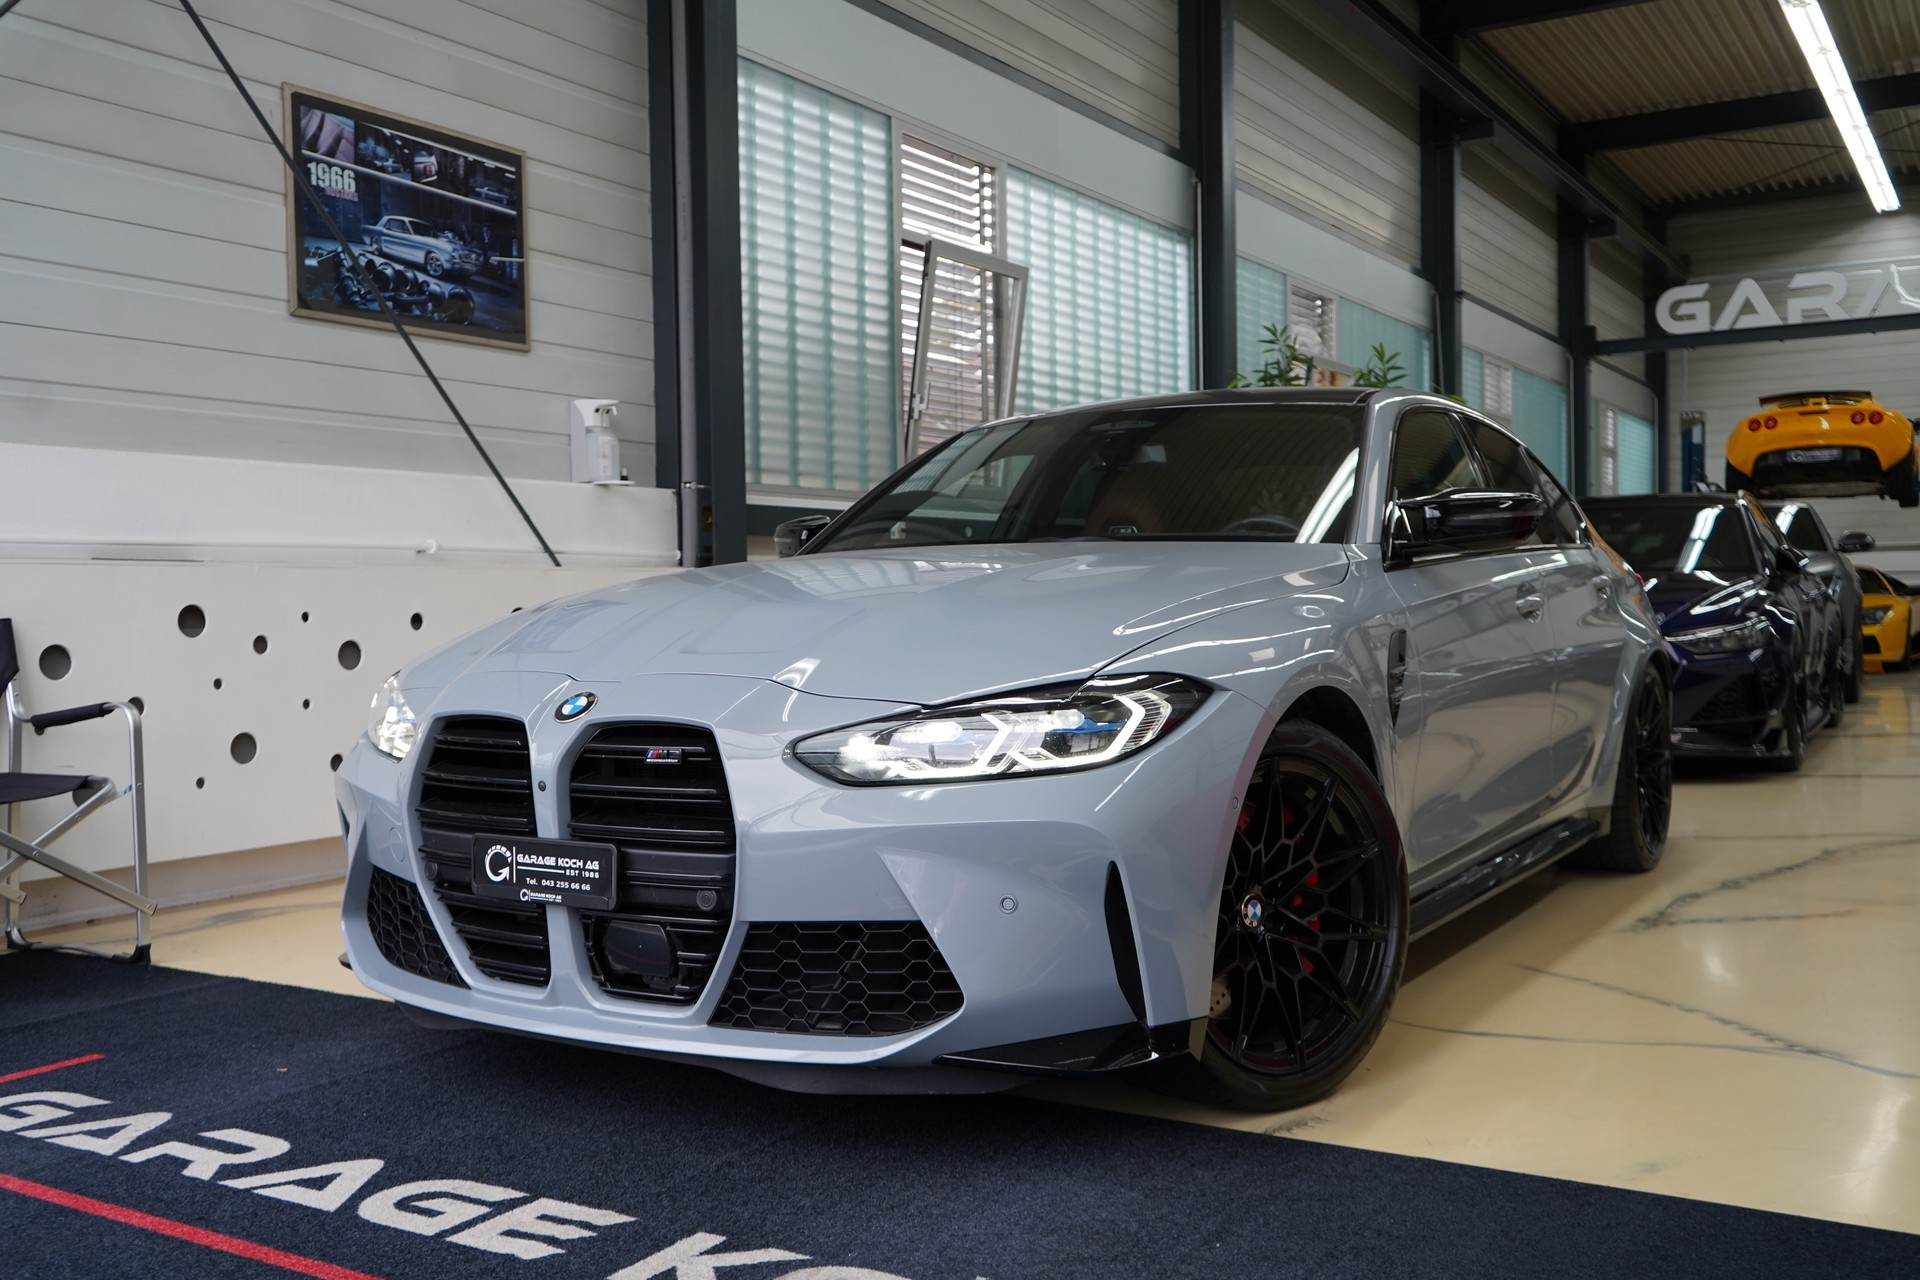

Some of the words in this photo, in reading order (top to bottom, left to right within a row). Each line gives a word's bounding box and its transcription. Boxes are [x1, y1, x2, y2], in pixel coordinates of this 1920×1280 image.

[307, 161, 356, 193] 1966
[517, 854, 556, 866] GARAGE
[558, 857, 583, 868] KOCH
[585, 860, 599, 870] AG
[565, 869, 580, 877] EST
[581, 870, 600, 879] 1986
[525, 877, 538, 886] Tel.
[541, 879, 555, 887] 043
[555, 881, 569, 889] 255
[570, 882, 580, 890] 66
[581, 883, 591, 891] 66
[0, 1091, 639, 1260] GARAGE
